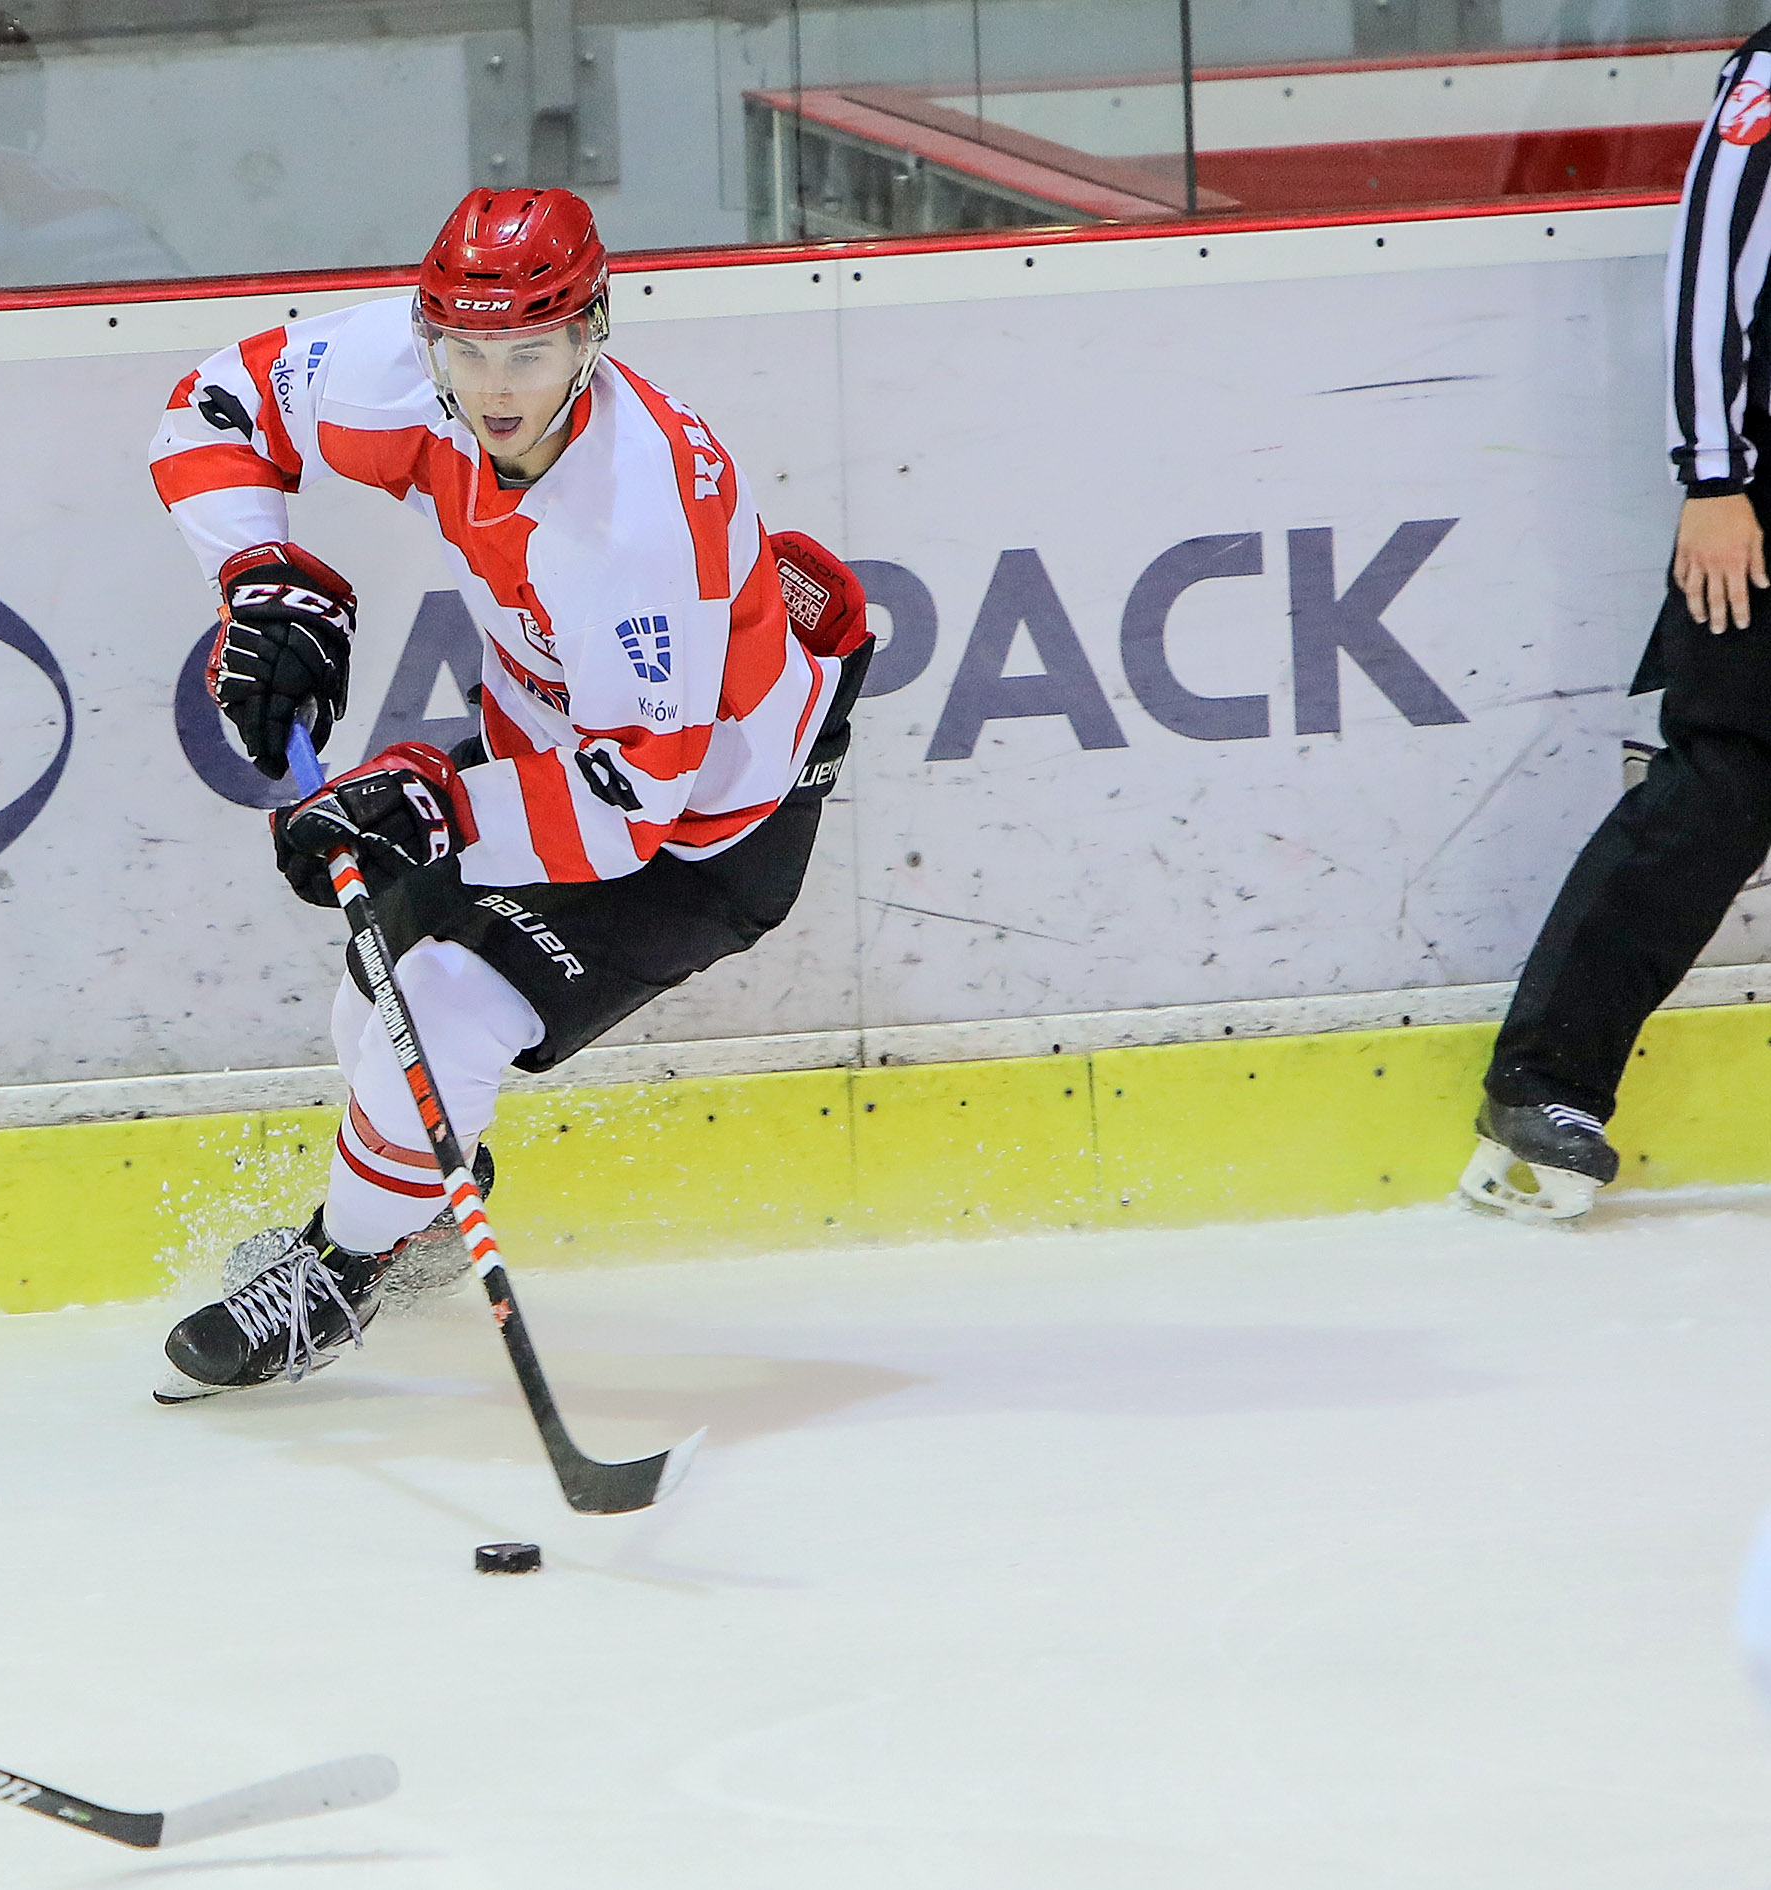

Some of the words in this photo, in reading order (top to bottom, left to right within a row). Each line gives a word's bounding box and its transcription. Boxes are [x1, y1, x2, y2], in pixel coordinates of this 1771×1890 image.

[454, 297, 513, 313] CCM
[273, 358, 295, 415] aków
[797, 757, 844, 788] UER
[473, 894, 586, 982] BAUER
[354, 927, 390, 988] COMARCH
[374, 979, 408, 1038] CRACOVIA
[393, 1031, 420, 1070] TEAM
